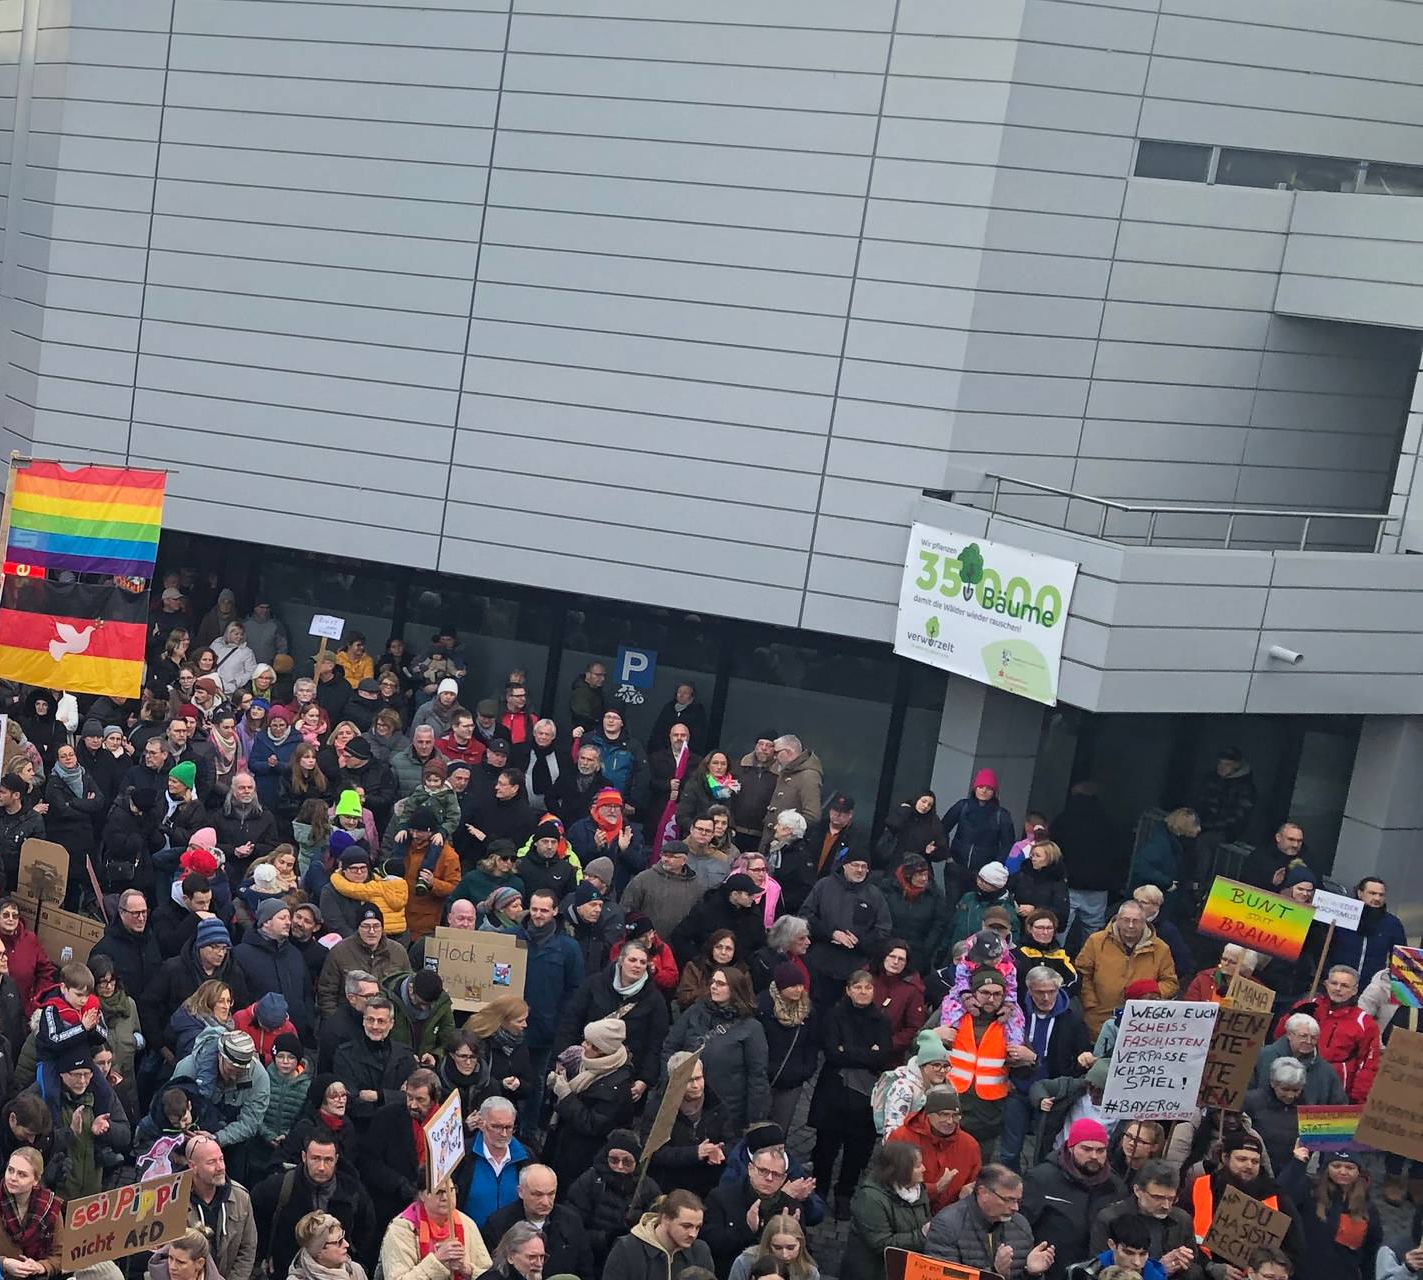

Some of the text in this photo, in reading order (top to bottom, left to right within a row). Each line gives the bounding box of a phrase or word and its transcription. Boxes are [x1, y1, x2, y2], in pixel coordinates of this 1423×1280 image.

[932, 542, 957, 554] pflanzen
[913, 594, 1022, 633] damit die Wälder wieder rauschen!
[982, 587, 1054, 628] Bäume
[907, 631, 954, 654] verwurzelt
[622, 651, 648, 680] P
[1231, 888, 1294, 919] BUNT
[1247, 912, 1274, 925] STATT
[1217, 917, 1288, 949] BRAUN
[1131, 1005, 1217, 1020] WEGEN EUCH
[1126, 1019, 1187, 1033] SCHEISS
[1123, 1035, 1205, 1048] FASCHISTEN
[1117, 1050, 1188, 1064] VERPASSE
[1114, 1065, 1165, 1078] ICH DAS
[1104, 1099, 1181, 1113] #BAYER04
[70, 1174, 183, 1230] sei Pippi
[1242, 1200, 1273, 1226] DU
[70, 1220, 164, 1261] nicht AfD
[1210, 1229, 1251, 1260] RECH
